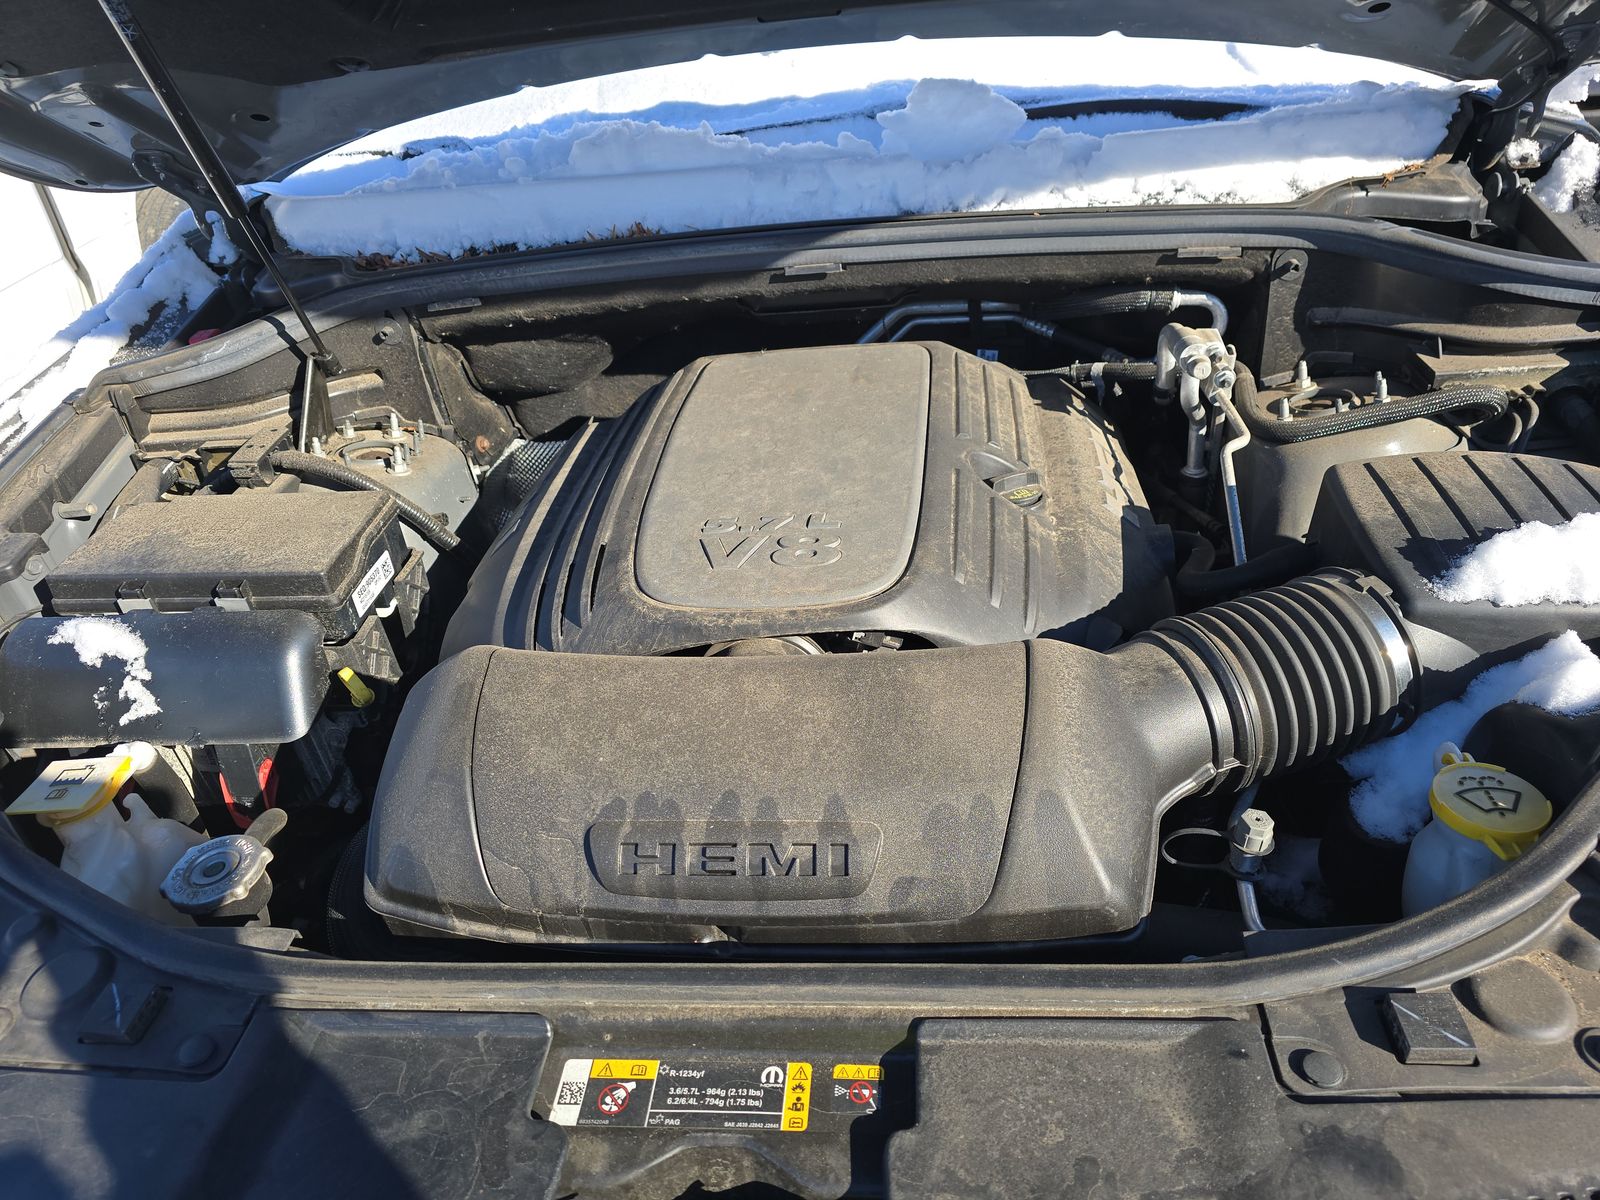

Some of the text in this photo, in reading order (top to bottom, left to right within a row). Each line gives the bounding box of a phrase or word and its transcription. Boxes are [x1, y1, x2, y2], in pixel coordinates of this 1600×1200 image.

[699, 535, 843, 570] V8
[617, 842, 850, 877] HEMI
[669, 1069, 705, 1079] R-1234yf
[668, 1087, 700, 1095] 3.6/5.7L
[706, 1088, 726, 1097] 964g
[728, 1088, 747, 1097] (2.13
[748, 1088, 764, 1098] lbs)
[667, 1097, 698, 1105] 6.2/6.4L
[705, 1098, 725, 1107] 794g
[726, 1098, 746, 1107] (1.75
[747, 1098, 762, 1108] lbs)
[664, 1118, 681, 1126] PAG
